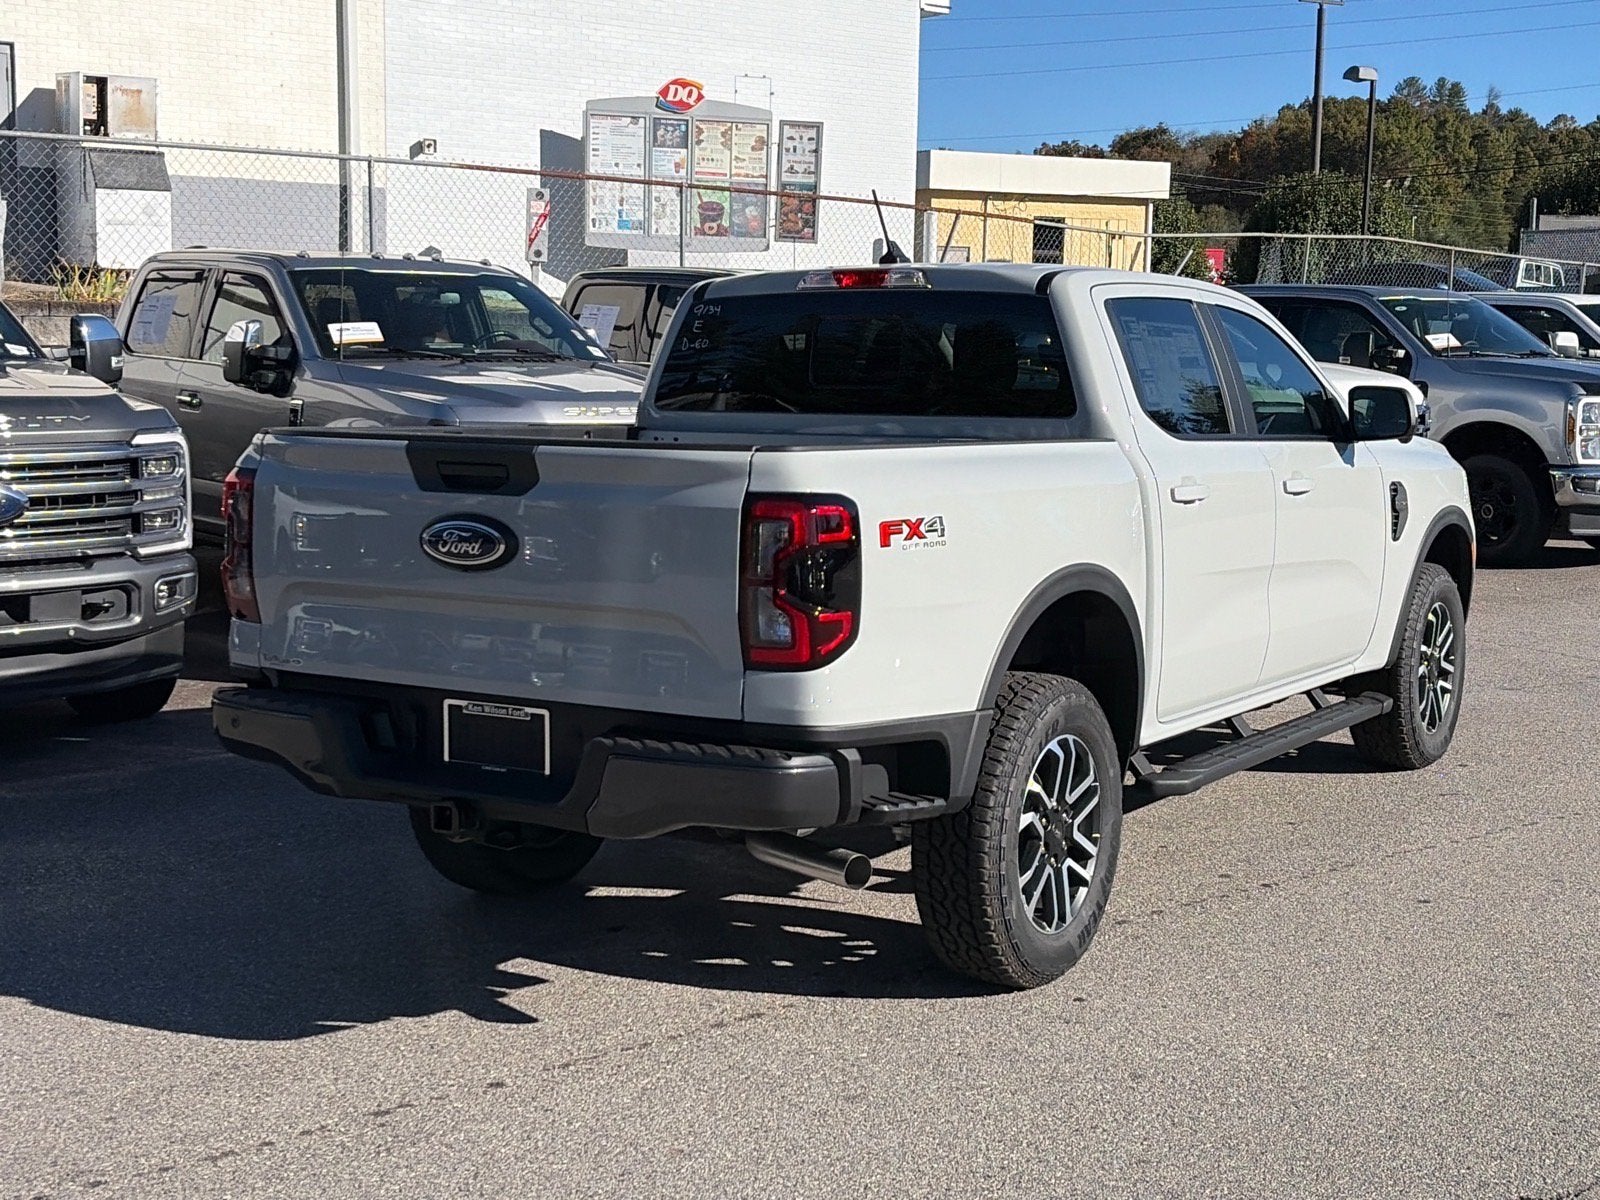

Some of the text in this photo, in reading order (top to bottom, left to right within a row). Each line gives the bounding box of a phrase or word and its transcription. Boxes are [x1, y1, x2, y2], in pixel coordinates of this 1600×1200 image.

[666, 84, 699, 106] DQ
[692, 320, 705, 333] E
[878, 515, 946, 549] FX4
[438, 528, 483, 556] Ford
[901, 539, 947, 551] OFF ROAD
[467, 703, 526, 717] Ken Wilson Ford
